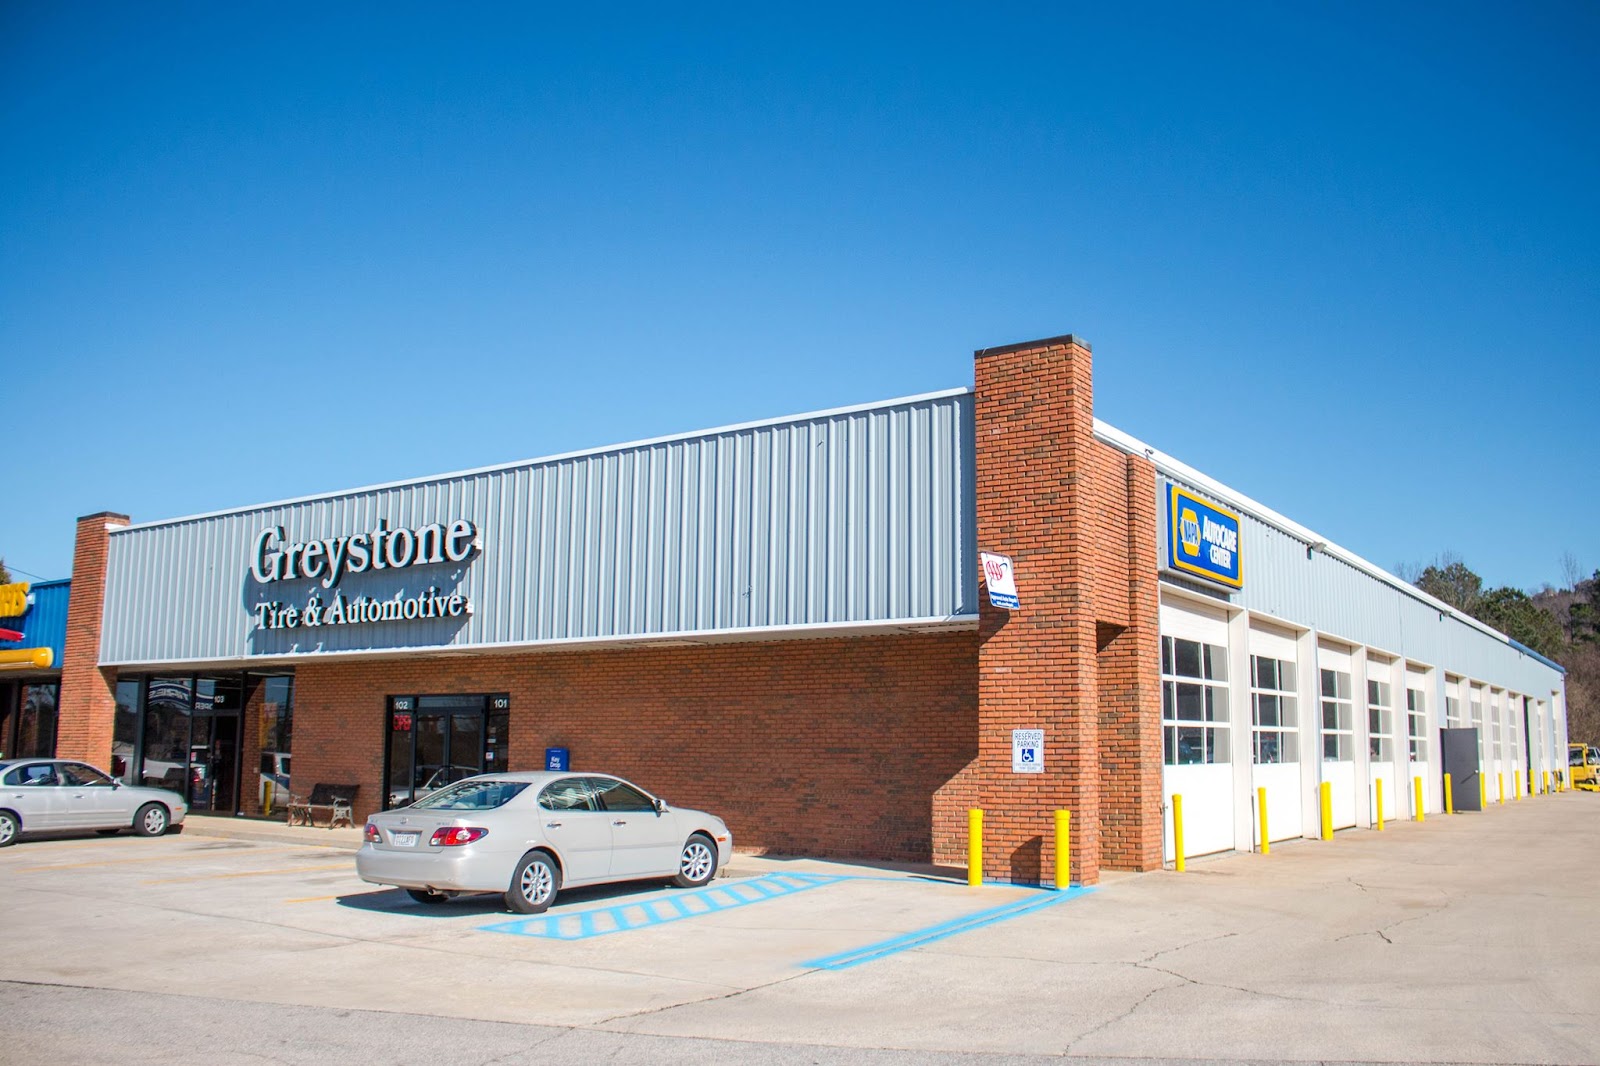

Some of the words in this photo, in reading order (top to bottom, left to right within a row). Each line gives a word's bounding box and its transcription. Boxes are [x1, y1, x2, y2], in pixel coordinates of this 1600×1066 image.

[251, 518, 477, 589] Greystone
[1210, 544, 1231, 569] CENTER
[255, 600, 298, 630] Tire
[305, 597, 322, 627] &
[328, 586, 468, 625] Automotive
[214, 695, 225, 704] 103
[395, 701, 408, 710] 102
[494, 699, 508, 709] 101
